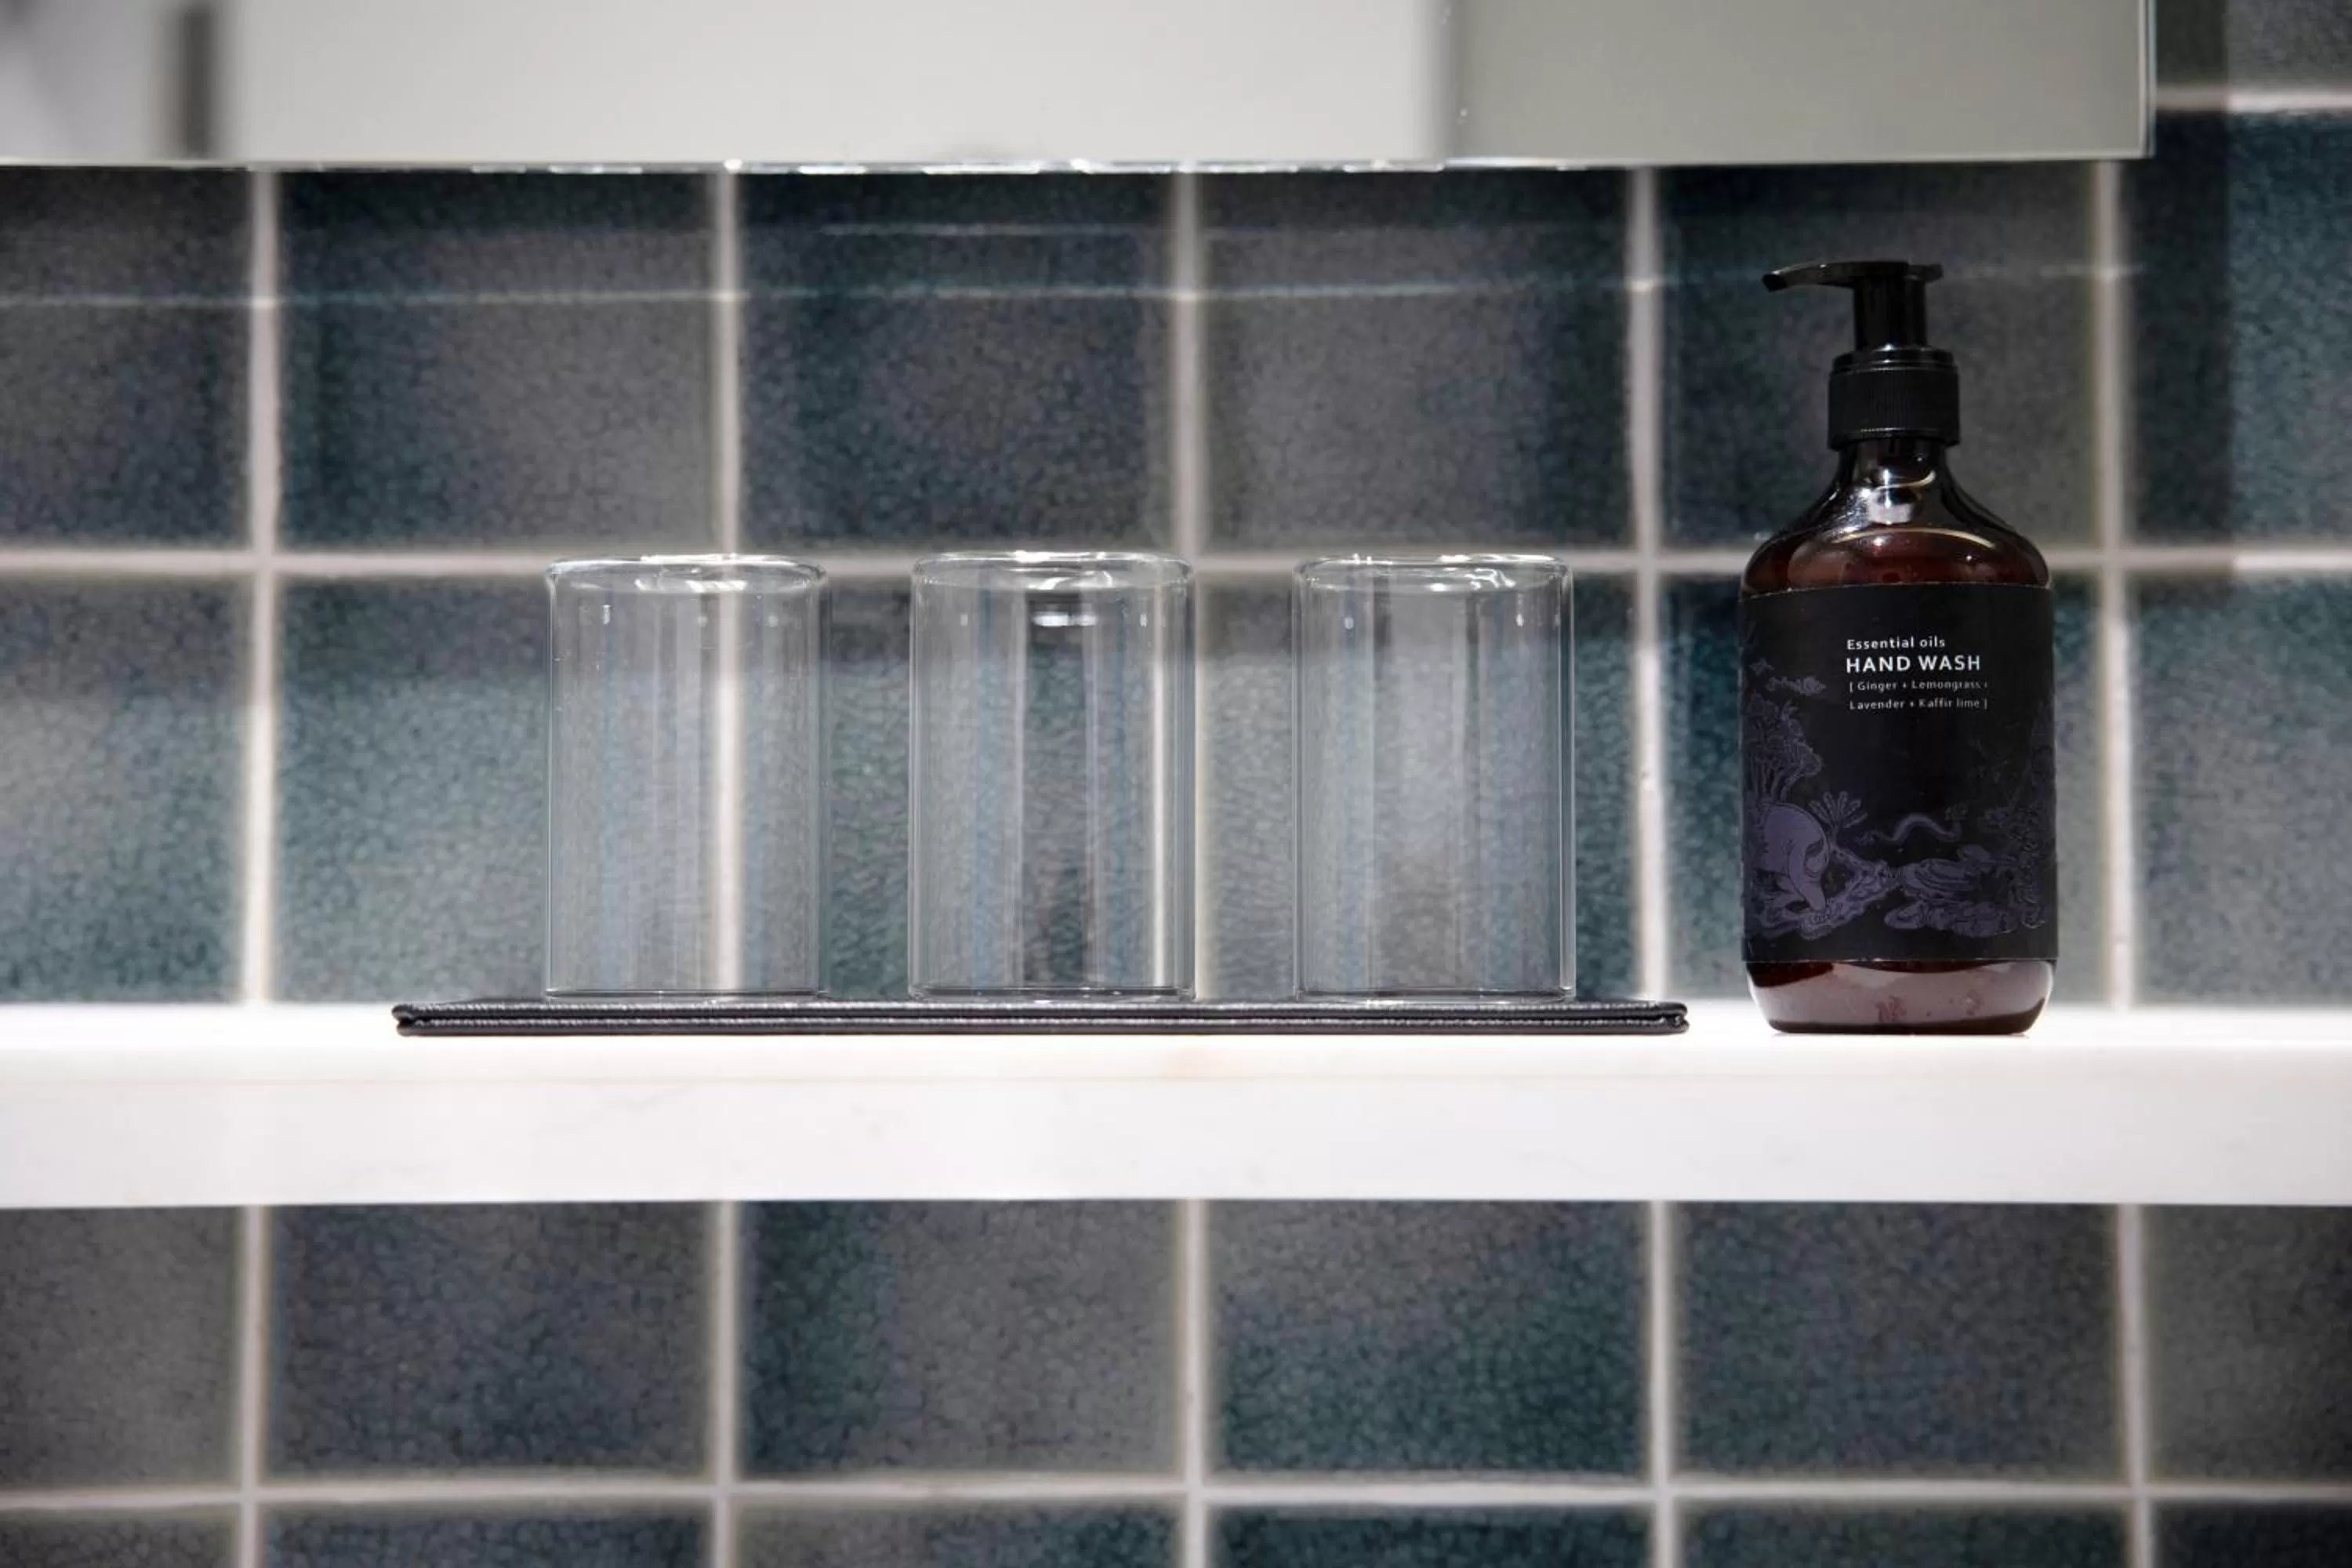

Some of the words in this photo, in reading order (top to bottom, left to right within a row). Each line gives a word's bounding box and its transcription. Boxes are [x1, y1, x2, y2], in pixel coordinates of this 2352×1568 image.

[1846, 636, 1915, 650] Essential
[1919, 636, 1946, 648] oils
[1846, 655, 1911, 673] HAND
[1918, 655, 1980, 672] WASH
[1857, 681, 1897, 693] Ginger
[1911, 680, 1981, 691] Lemongrass
[1849, 699, 1905, 710] Lavender
[1918, 697, 1953, 709] Kaffir
[1956, 697, 1980, 709] lime
